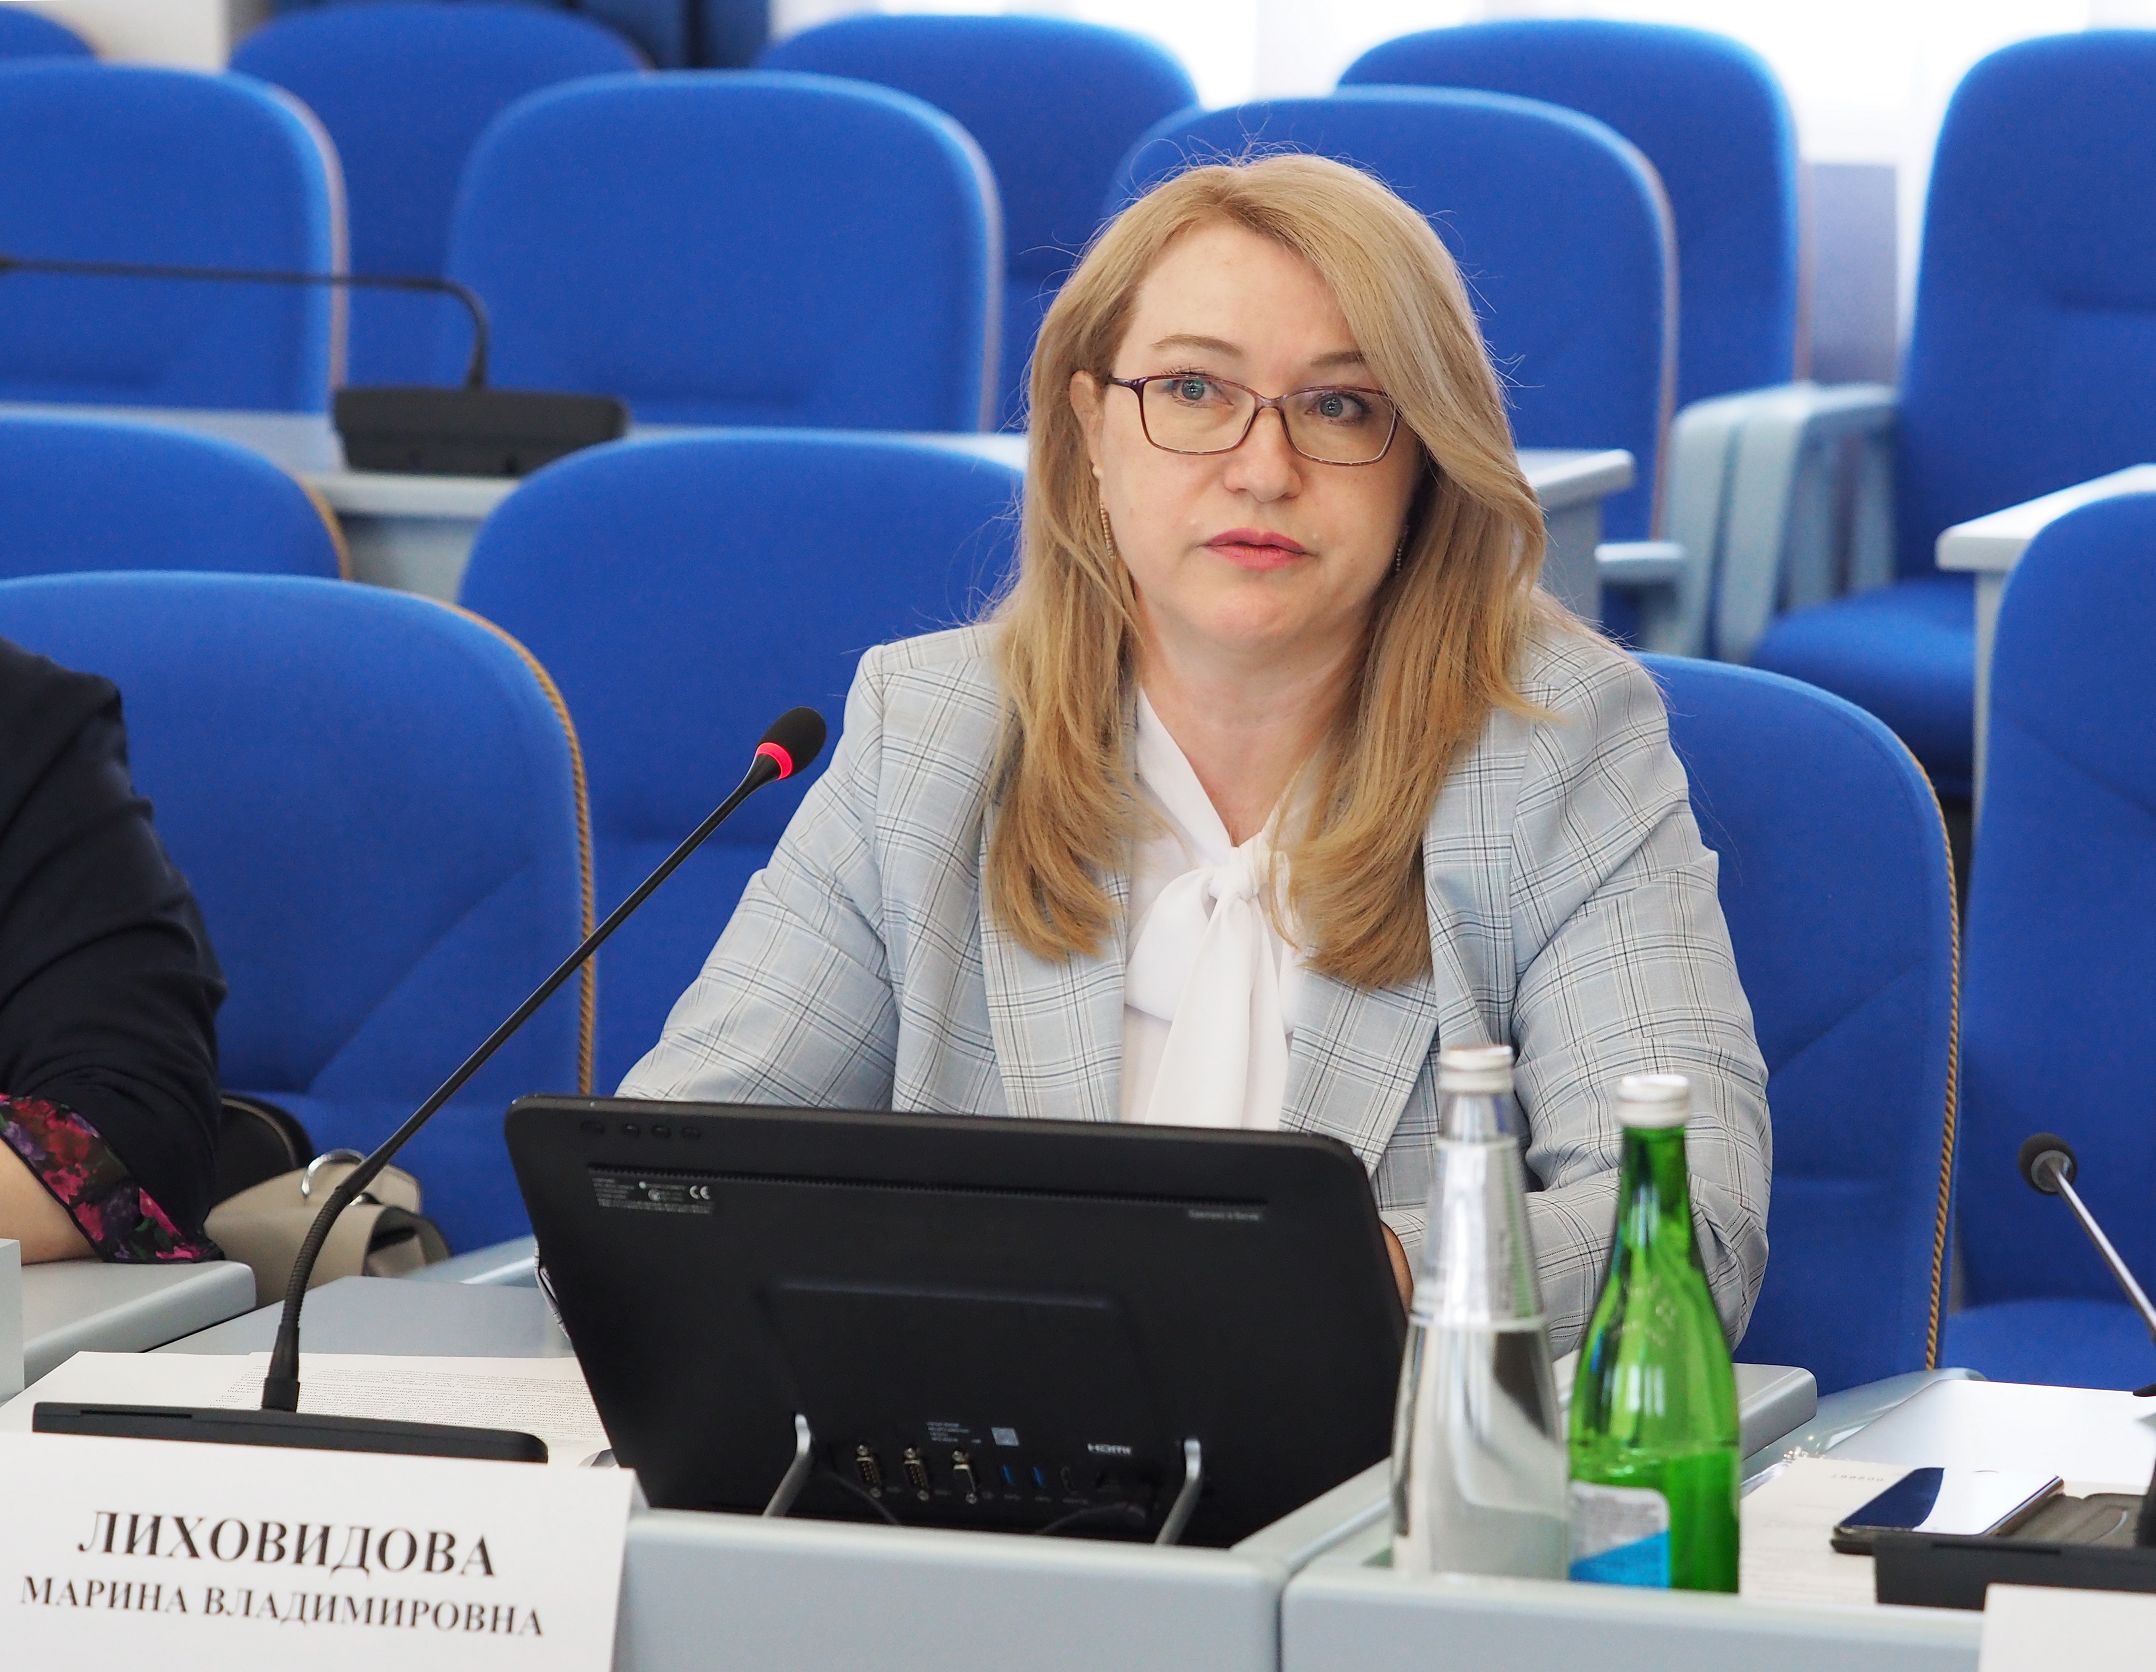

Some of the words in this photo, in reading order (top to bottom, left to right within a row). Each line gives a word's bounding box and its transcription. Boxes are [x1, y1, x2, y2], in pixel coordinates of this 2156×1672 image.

[77, 1510, 496, 1578] ЛИХОВИДОВА
[20, 1575, 189, 1614] МАРИНА
[203, 1586, 545, 1637] ВЛАДИМИРОВНА
